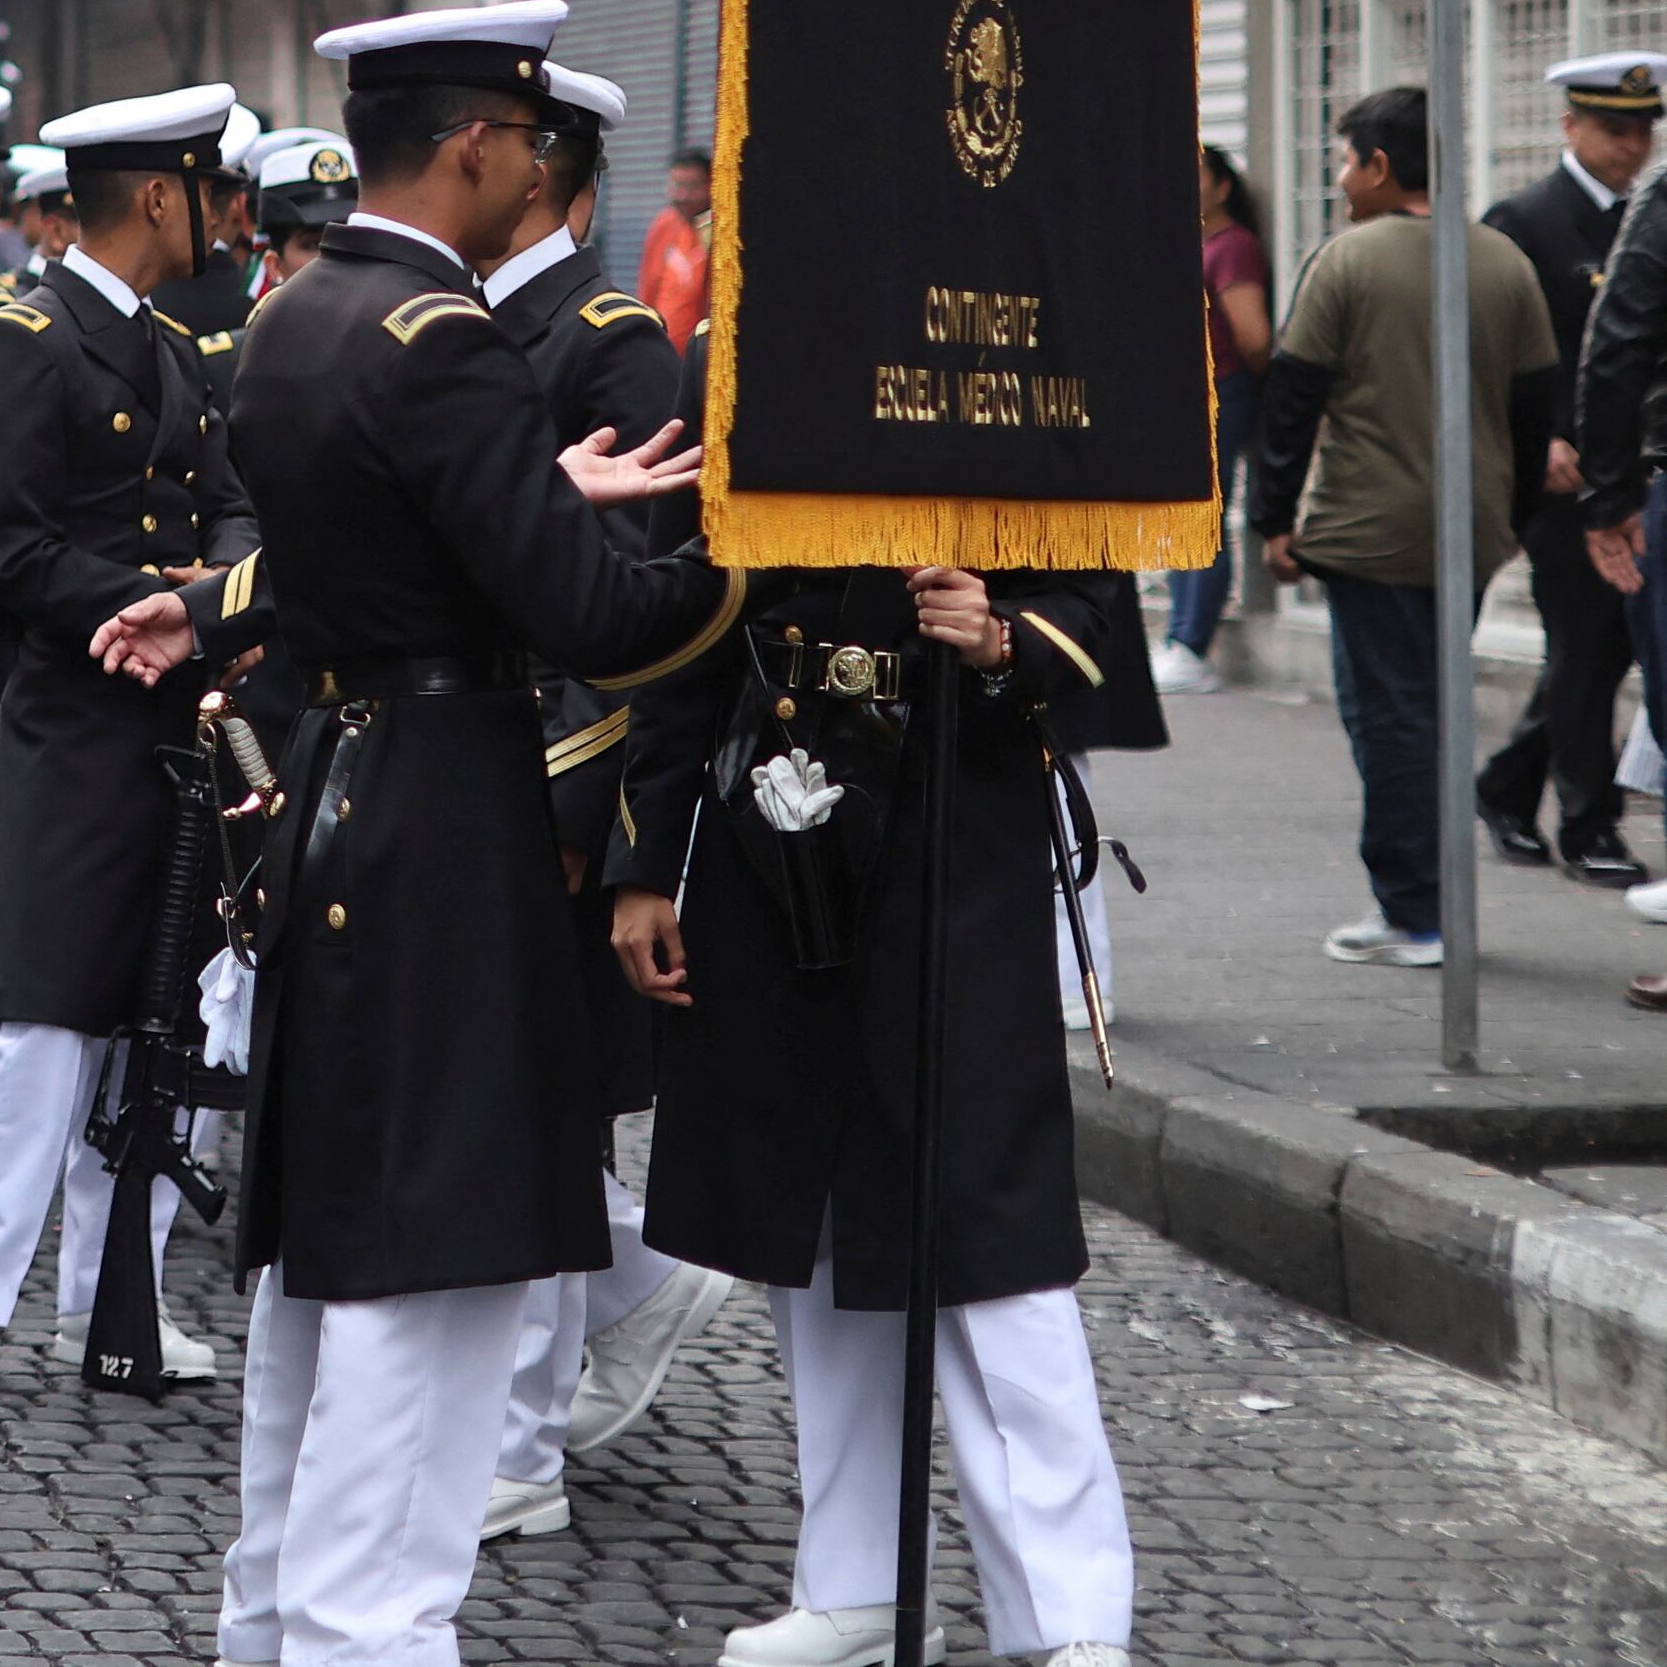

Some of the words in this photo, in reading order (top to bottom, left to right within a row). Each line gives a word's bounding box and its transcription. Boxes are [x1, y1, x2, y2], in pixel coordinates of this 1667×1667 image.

[983, 170, 997, 188] DE
[925, 285, 1041, 349] CONTINGENTE
[874, 363, 951, 423] ESCUELA
[1031, 374, 1092, 428] NAVAL
[99, 1354, 134, 1379] 127
